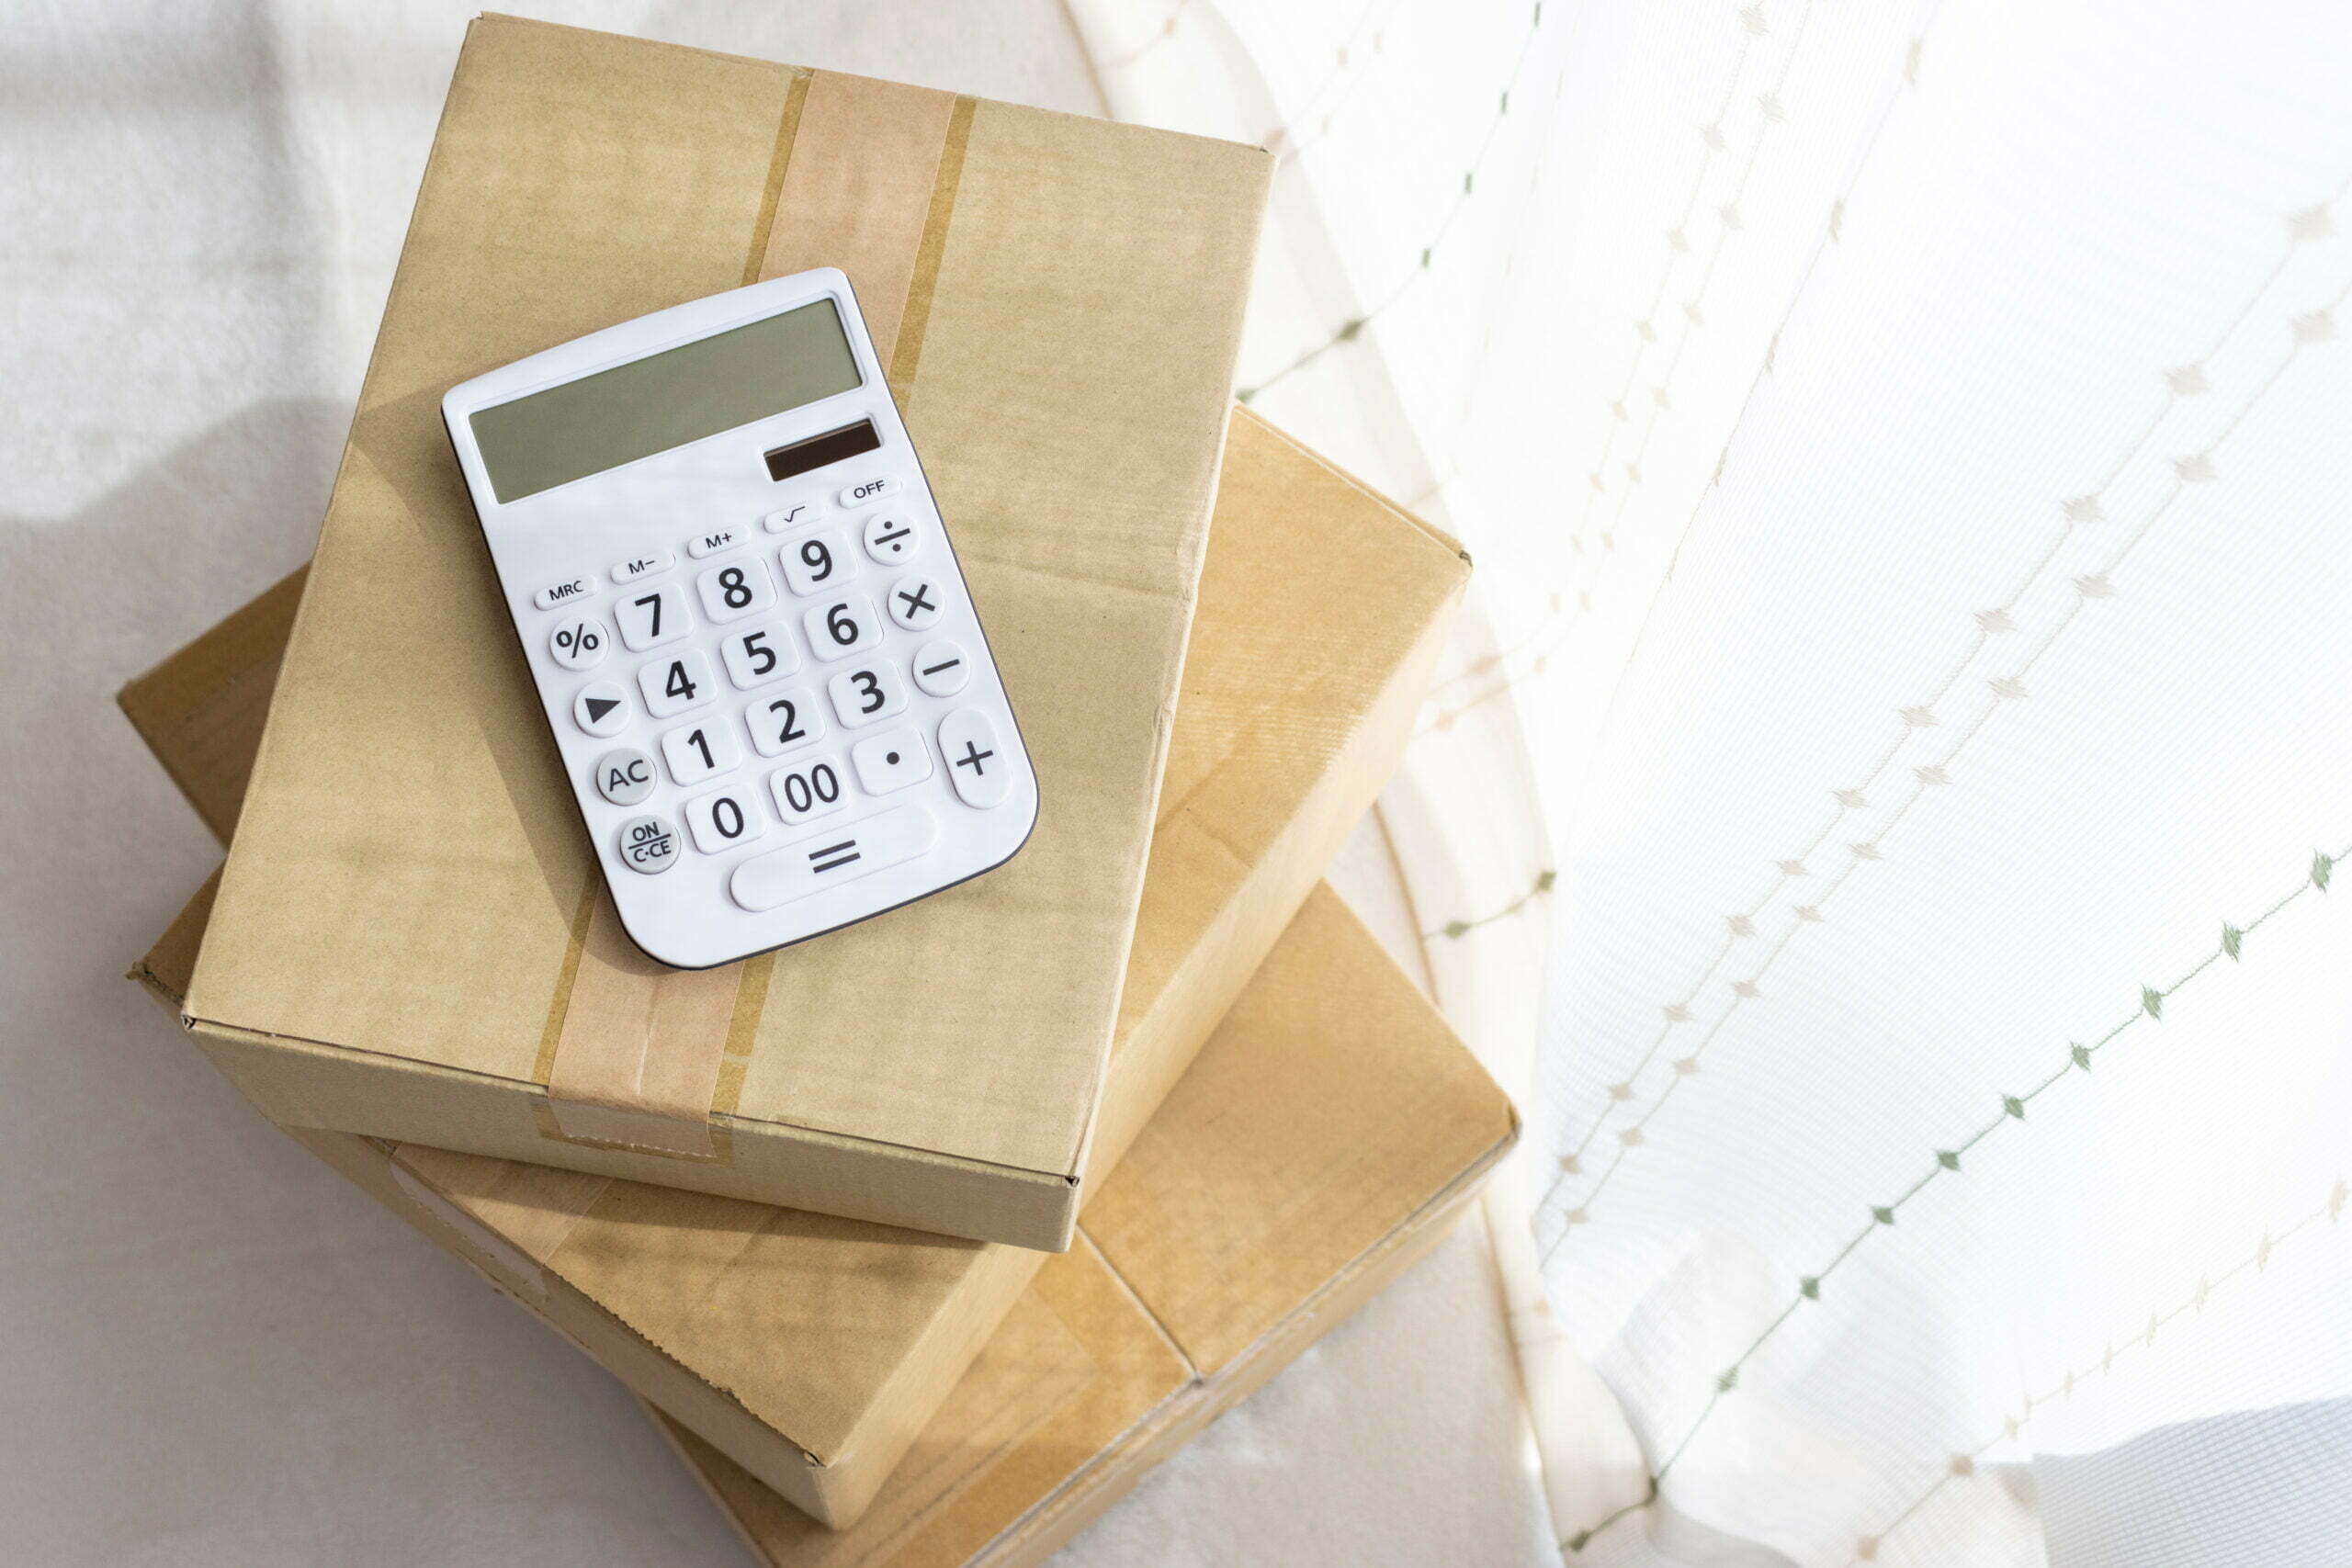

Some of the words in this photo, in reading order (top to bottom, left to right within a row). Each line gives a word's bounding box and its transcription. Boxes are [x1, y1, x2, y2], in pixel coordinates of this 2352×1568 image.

[854, 479, 886, 499] OFF
[705, 531, 733, 550] M+
[800, 540, 833, 582] 9
[548, 580, 584, 602] MRC
[718, 567, 753, 609] 8
[634, 592, 662, 637] 7
[827, 603, 860, 646] 6
[556, 623, 599, 659] %
[742, 631, 777, 675] 5
[665, 660, 697, 701] 4
[850, 671, 886, 714] 3
[769, 699, 806, 744] 2
[687, 728, 716, 769] 1
[608, 759, 650, 792] AC
[784, 763, 840, 813] 00
[632, 821, 661, 842] ON
[711, 797, 745, 839] 0
